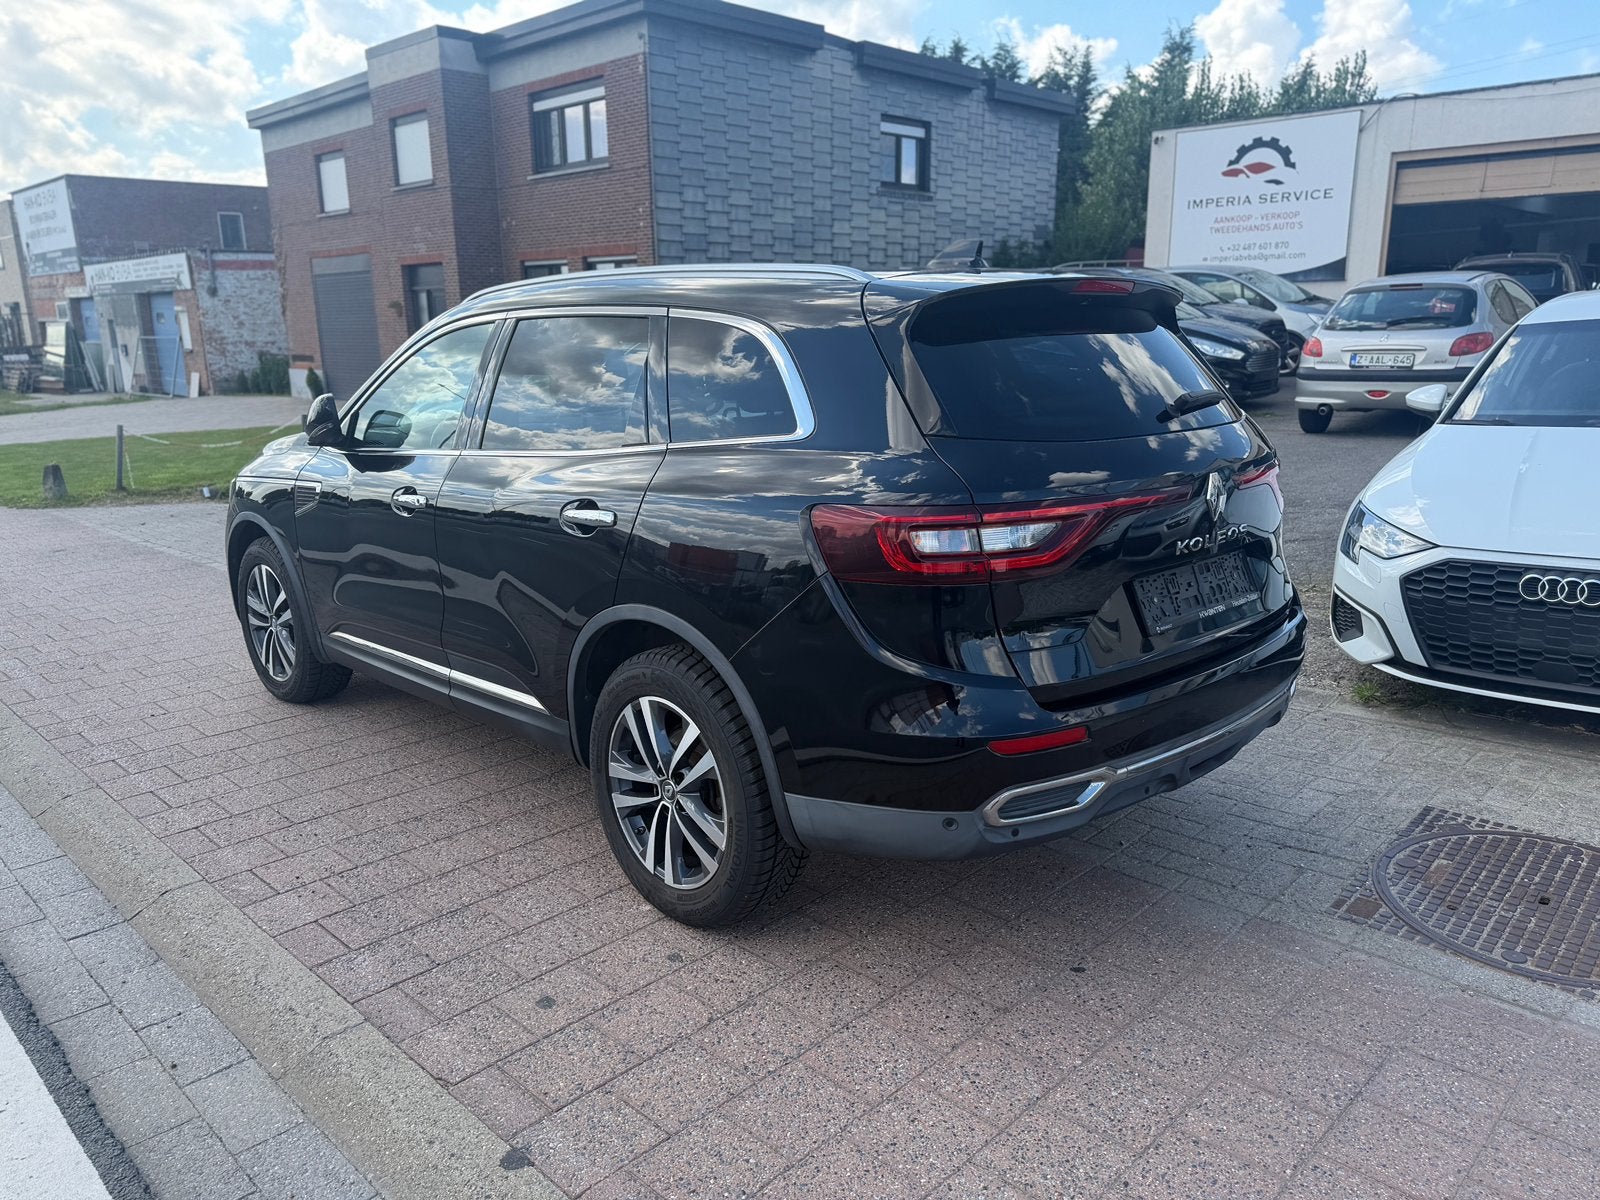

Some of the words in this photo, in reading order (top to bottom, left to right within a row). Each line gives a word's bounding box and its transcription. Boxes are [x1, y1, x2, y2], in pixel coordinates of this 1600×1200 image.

[1187, 195, 1252, 210] IMPERIA
[1258, 188, 1334, 204] SERVICE
[1213, 215, 1253, 224] AANKOOP
[1260, 211, 1301, 221] VERKOOP
[1209, 224, 1271, 235] TWEEDEHANDS
[1272, 221, 1304, 231] AUTO'S
